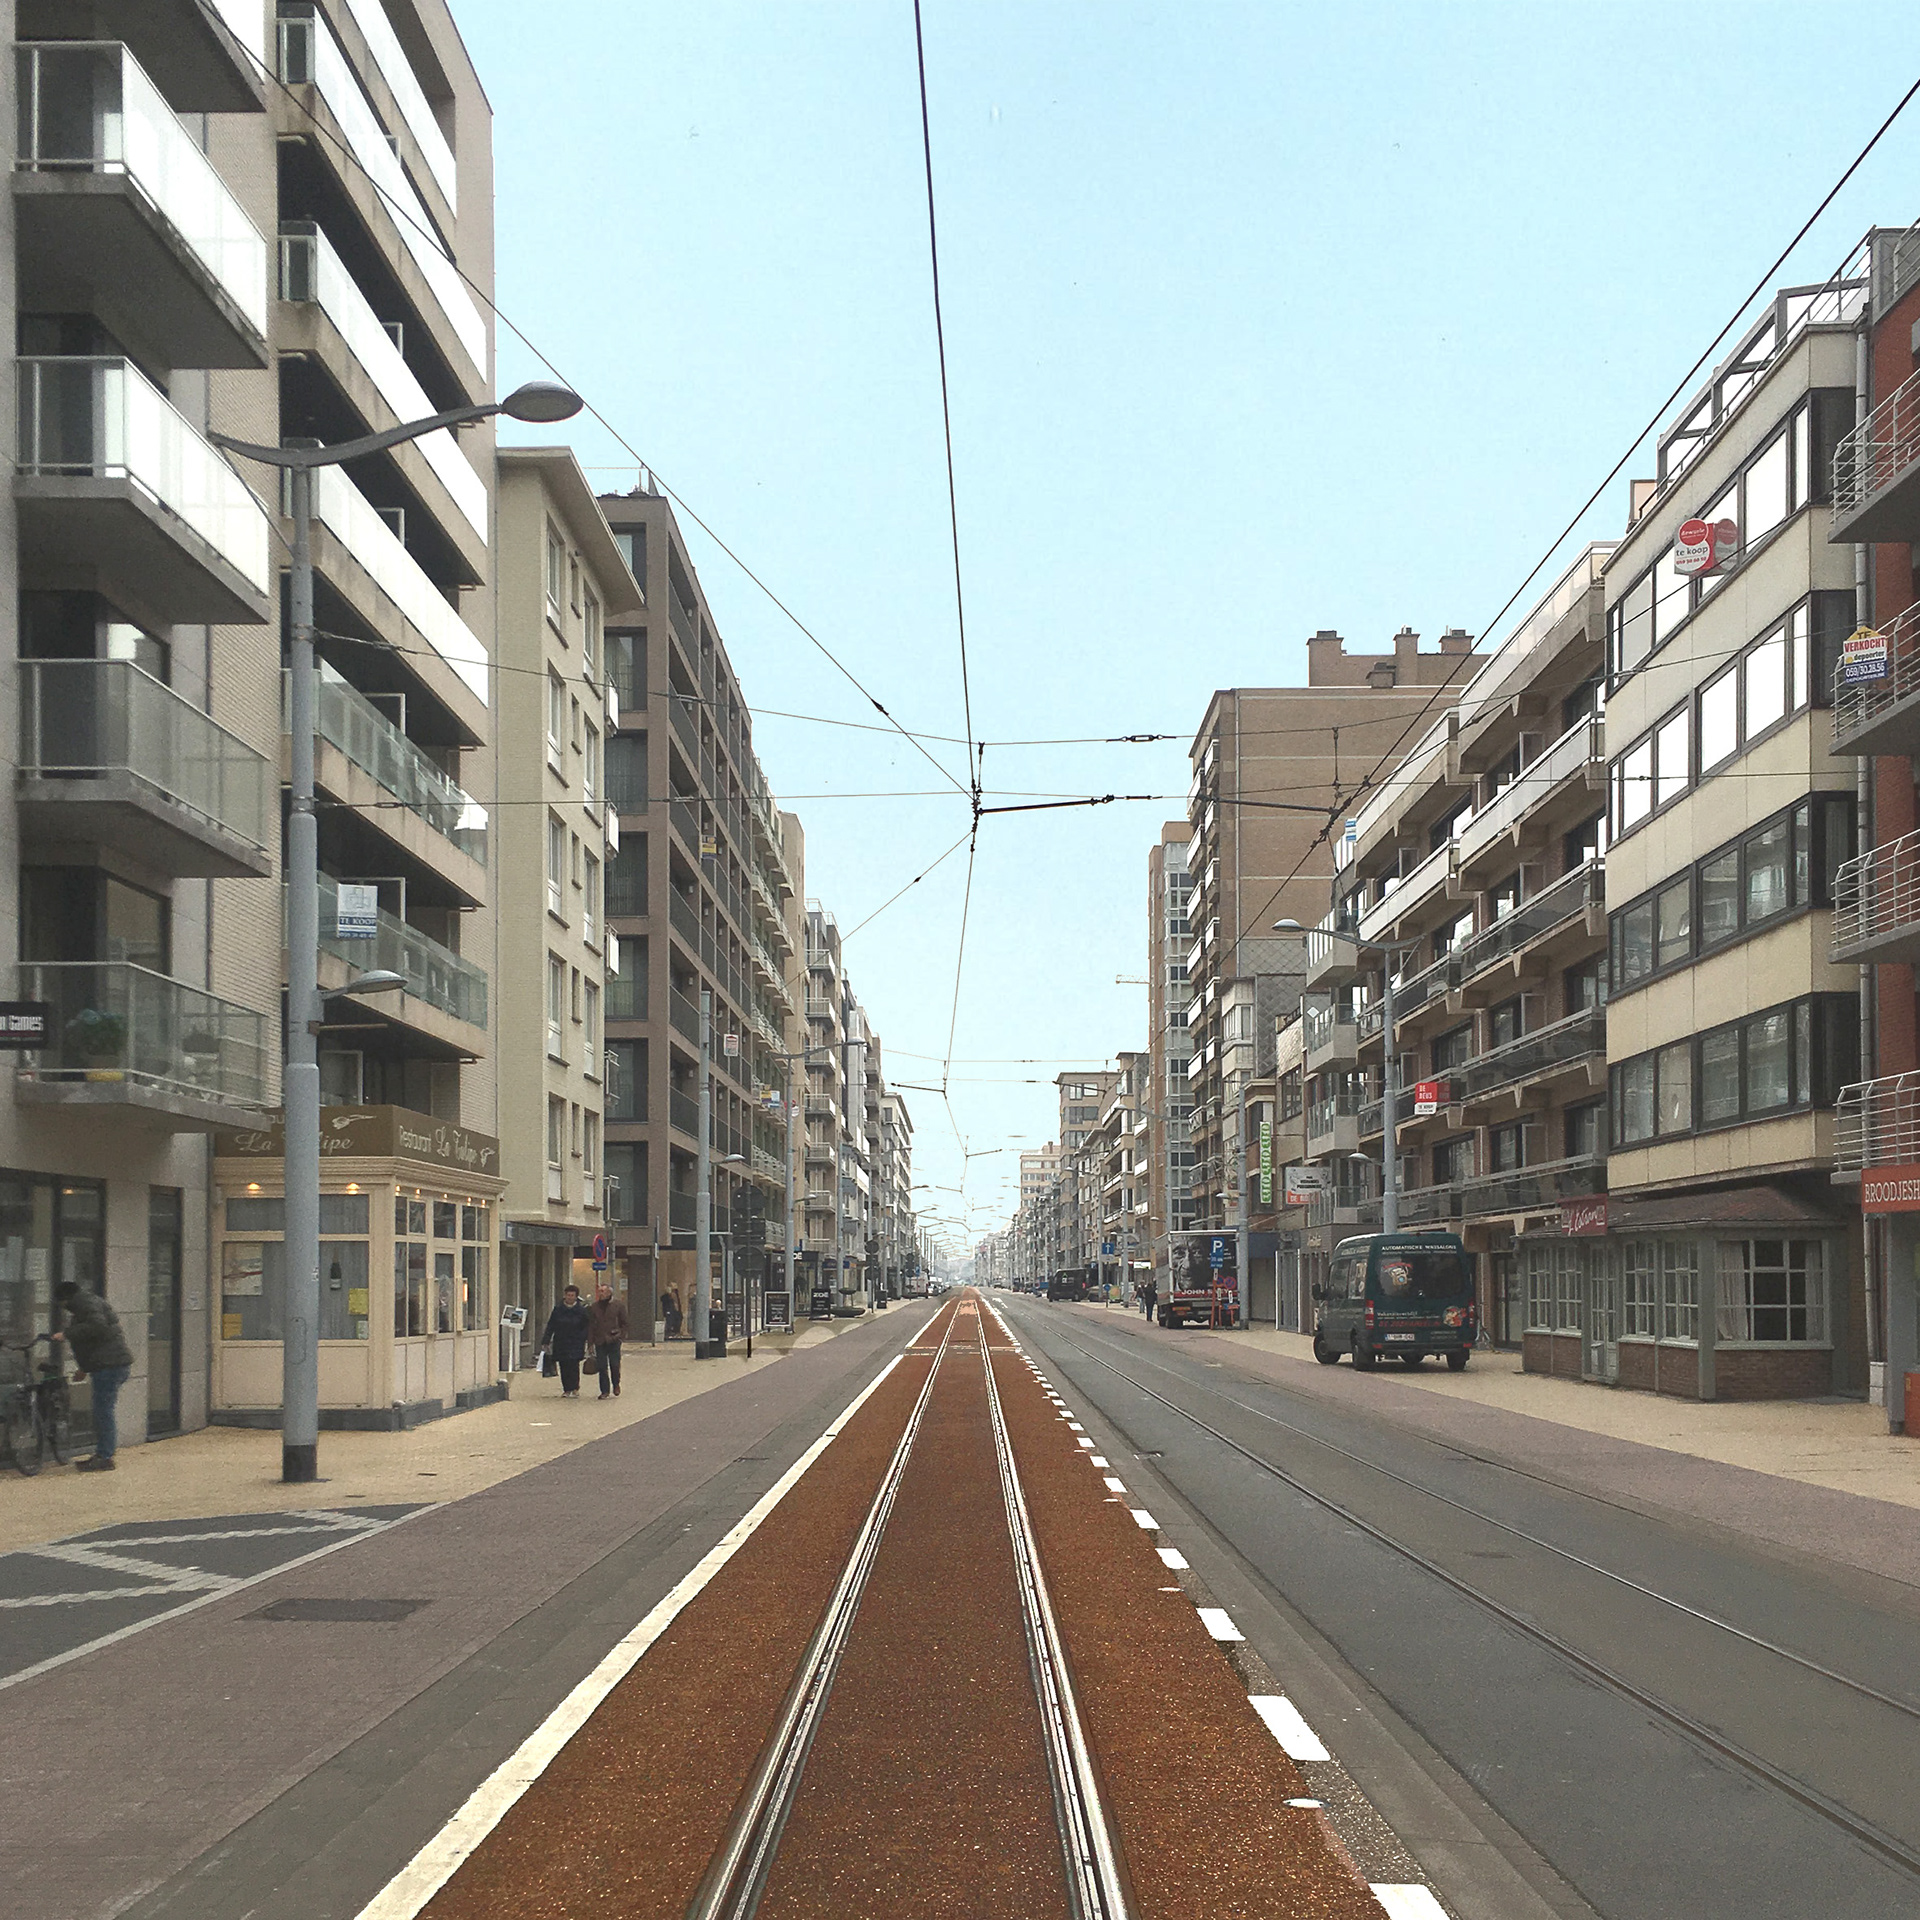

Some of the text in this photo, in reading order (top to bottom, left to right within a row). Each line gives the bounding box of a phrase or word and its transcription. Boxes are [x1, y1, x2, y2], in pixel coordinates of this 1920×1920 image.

[1687, 546, 1708, 555] koop
[1845, 638, 1885, 653] VERKOCHT
[234, 1132, 274, 1152] La
[399, 1124, 432, 1154] Restaurant
[1212, 1240, 1223, 1253] P
